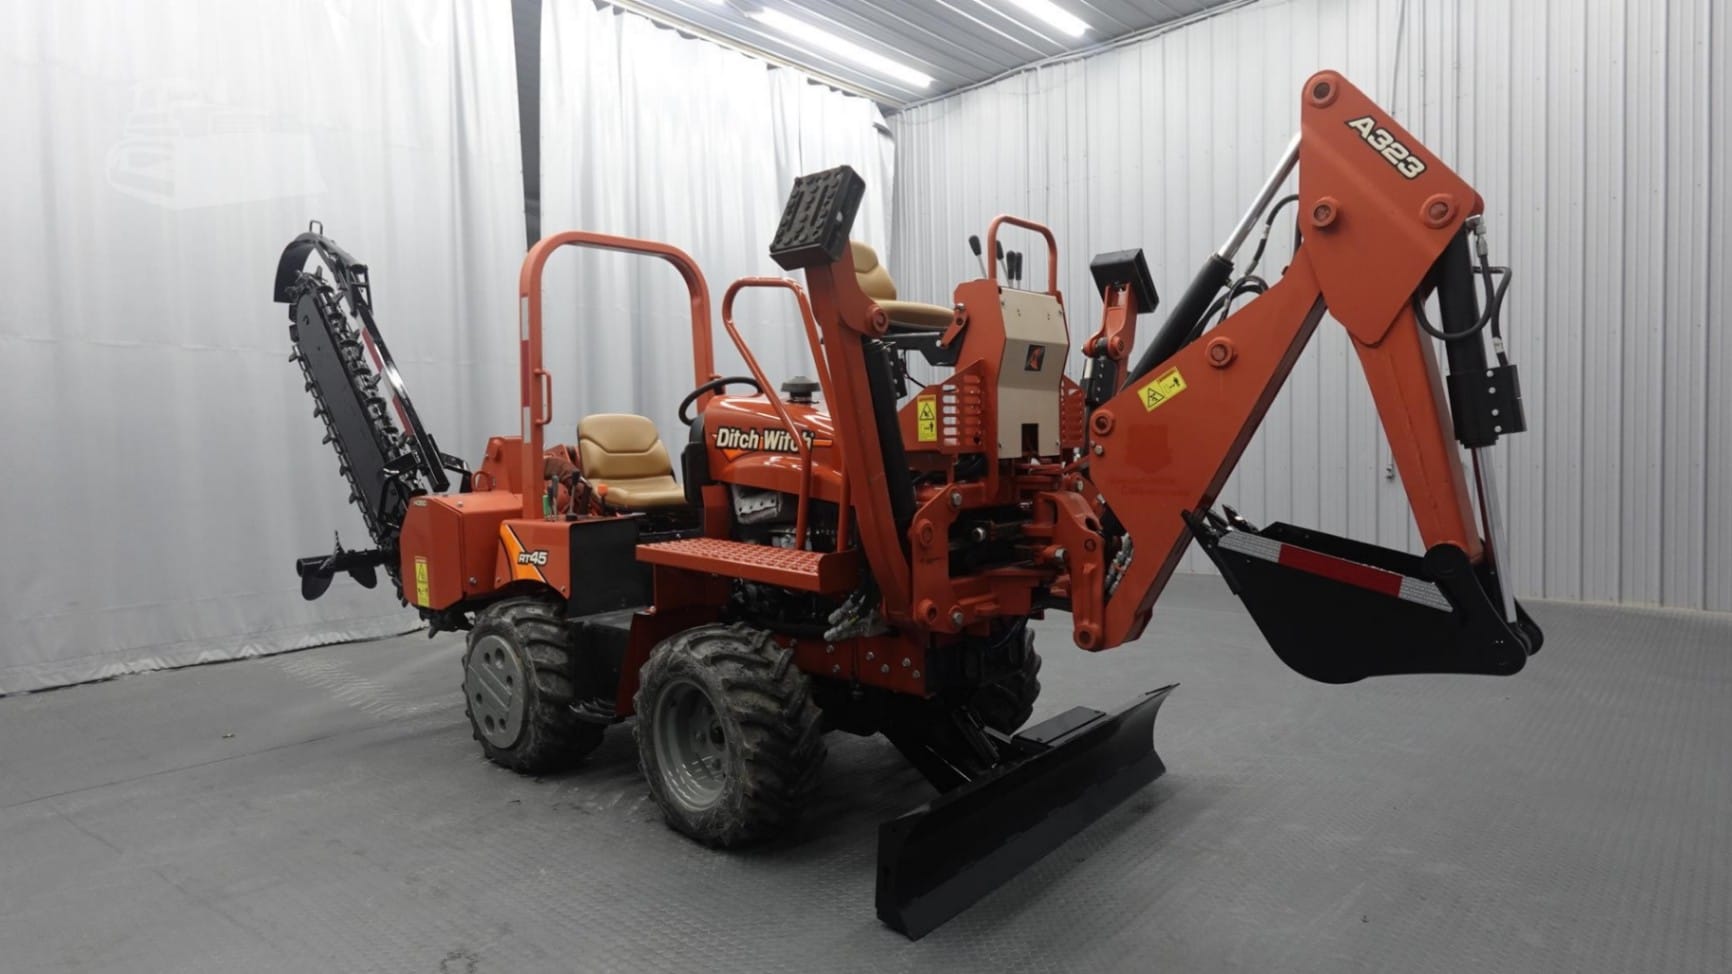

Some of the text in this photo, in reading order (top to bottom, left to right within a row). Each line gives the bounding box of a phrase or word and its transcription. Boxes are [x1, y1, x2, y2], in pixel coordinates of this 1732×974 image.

[1346, 116, 1426, 179] A323
[716, 427, 760, 450] Ditch
[518, 550, 548, 565] RT45
